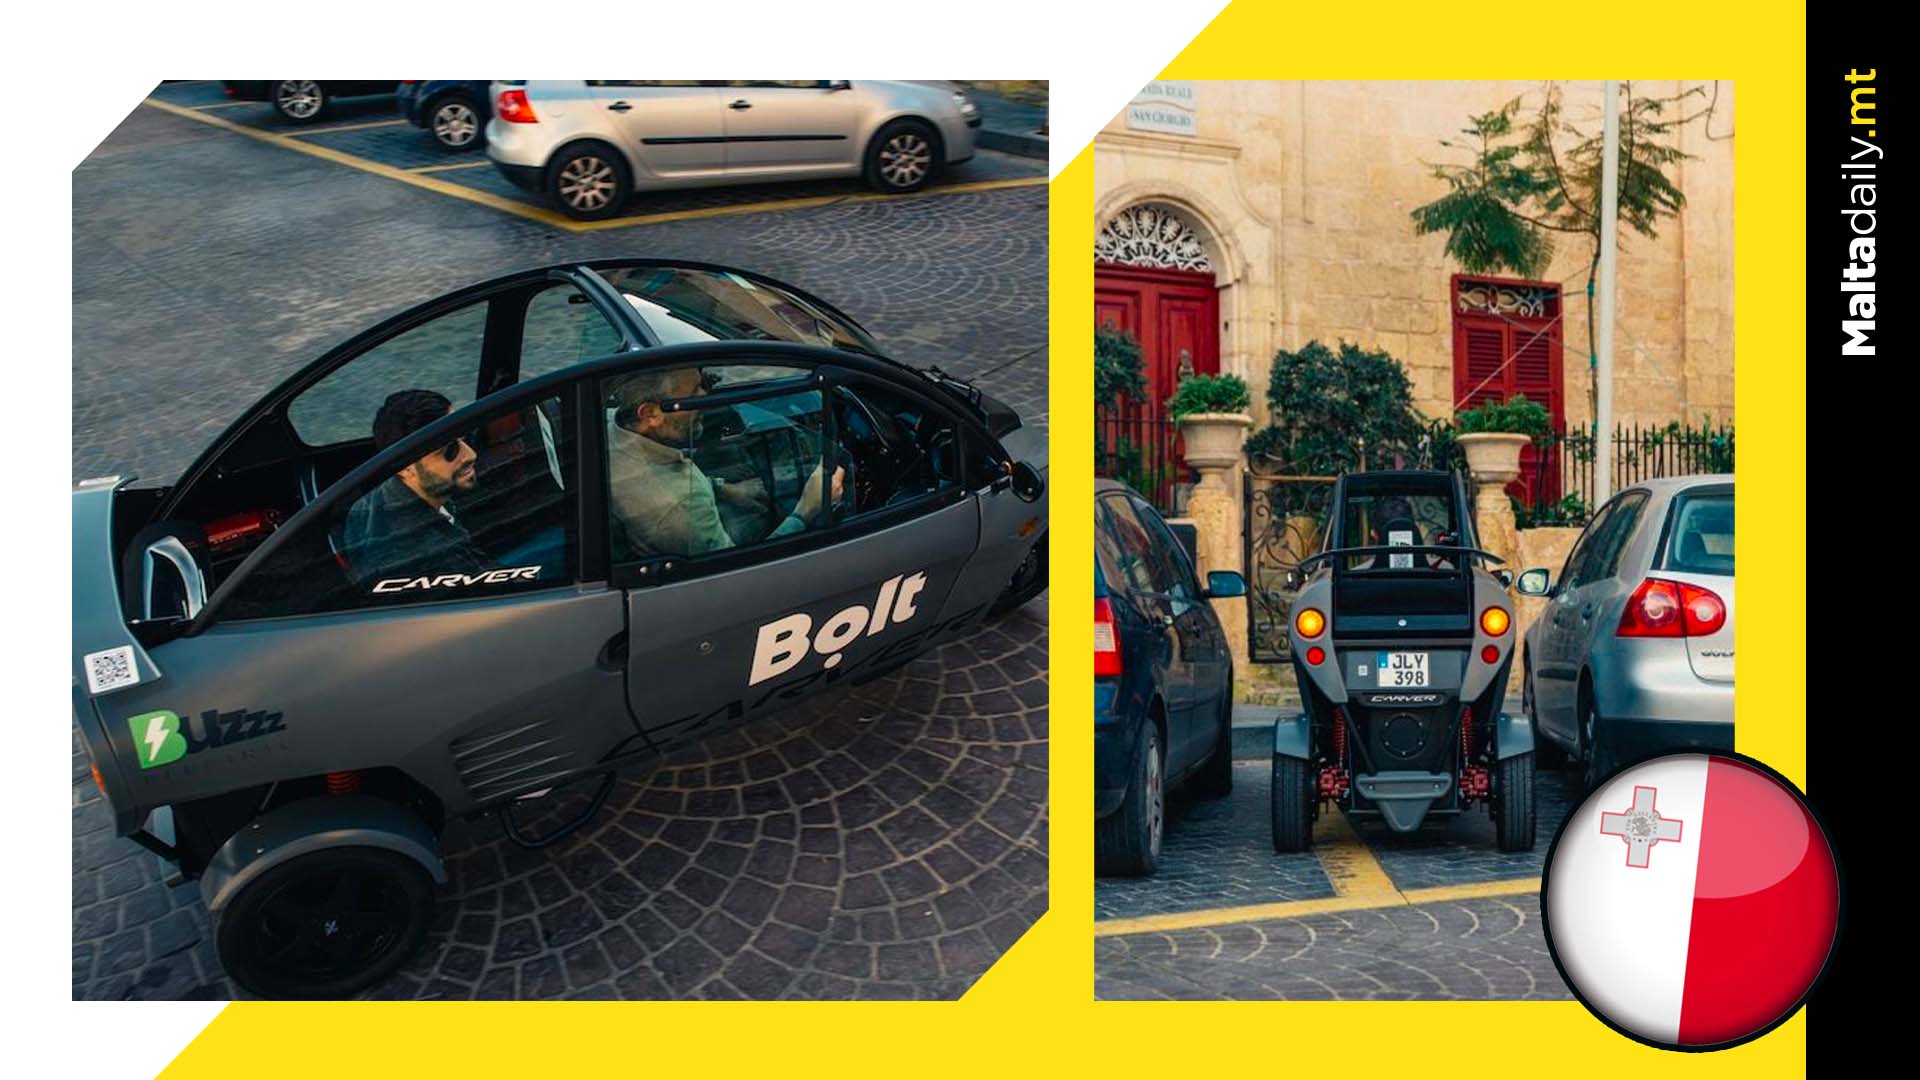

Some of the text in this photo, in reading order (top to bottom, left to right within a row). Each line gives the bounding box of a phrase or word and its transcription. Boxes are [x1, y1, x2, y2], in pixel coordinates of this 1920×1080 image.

[372, 565, 543, 593] CARVER
[748, 570, 928, 687] Bolt
[1392, 654, 1425, 669] JLY
[1394, 671, 1424, 686] 398
[1371, 694, 1437, 702] CARVER
